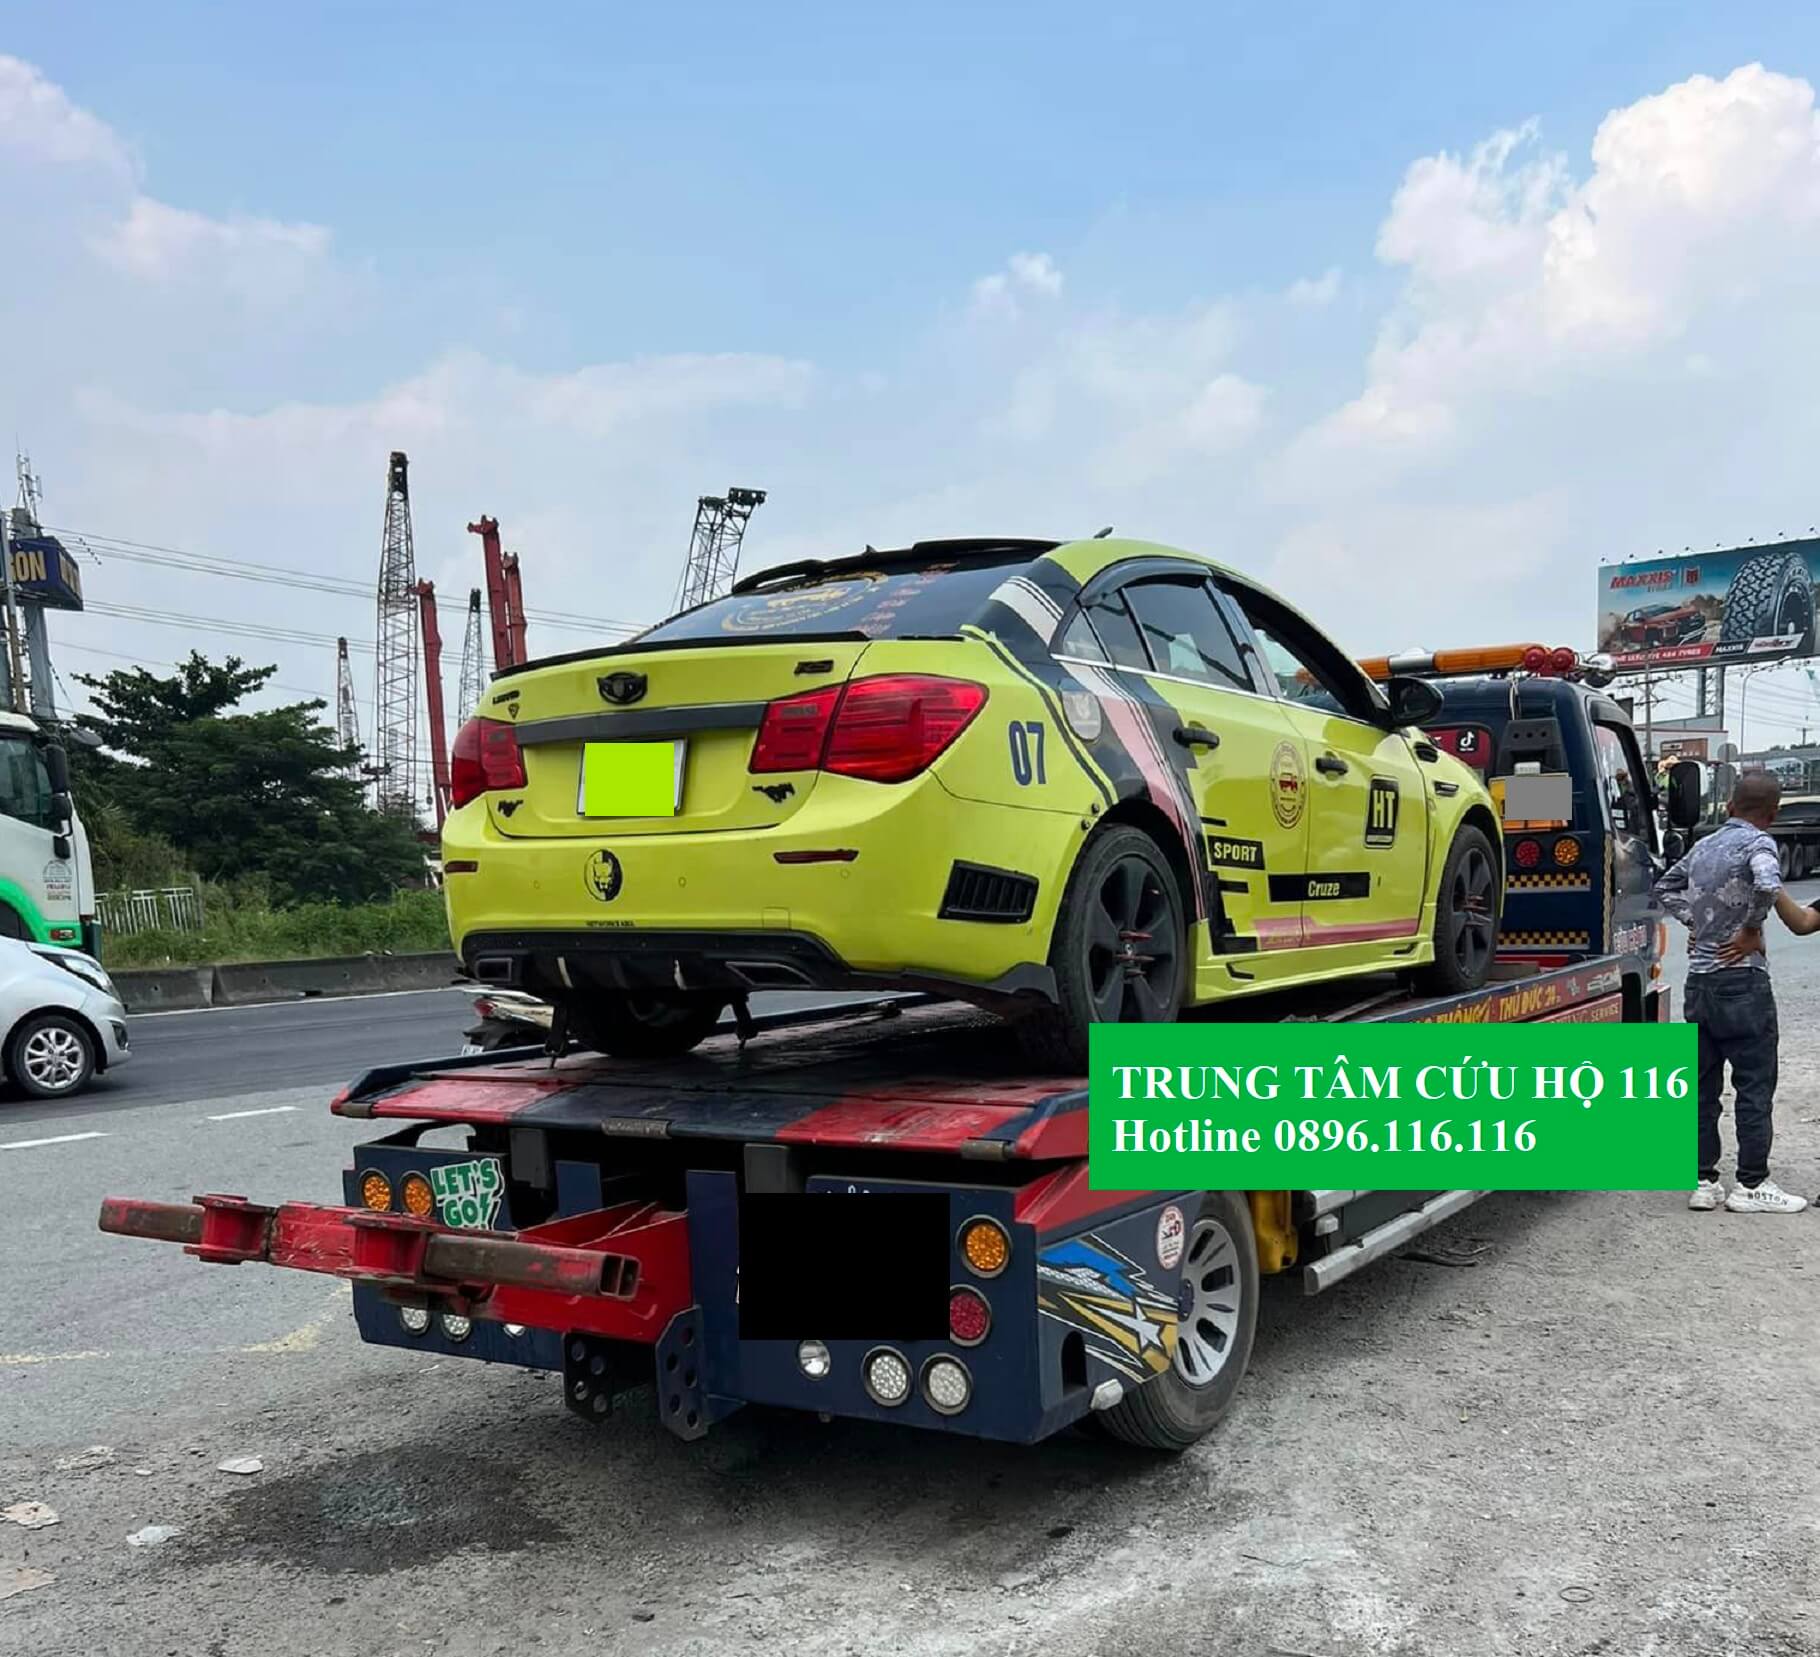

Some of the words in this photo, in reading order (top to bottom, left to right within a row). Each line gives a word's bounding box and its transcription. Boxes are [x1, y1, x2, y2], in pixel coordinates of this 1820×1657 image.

[1610, 569, 1672, 590] MAXXIS
[1008, 720, 1047, 786] 07
[1373, 788, 1396, 830] HT
[1213, 841, 1258, 863] SPORT
[1307, 880, 1341, 898] Cruze
[431, 1160, 498, 1197] LET'S
